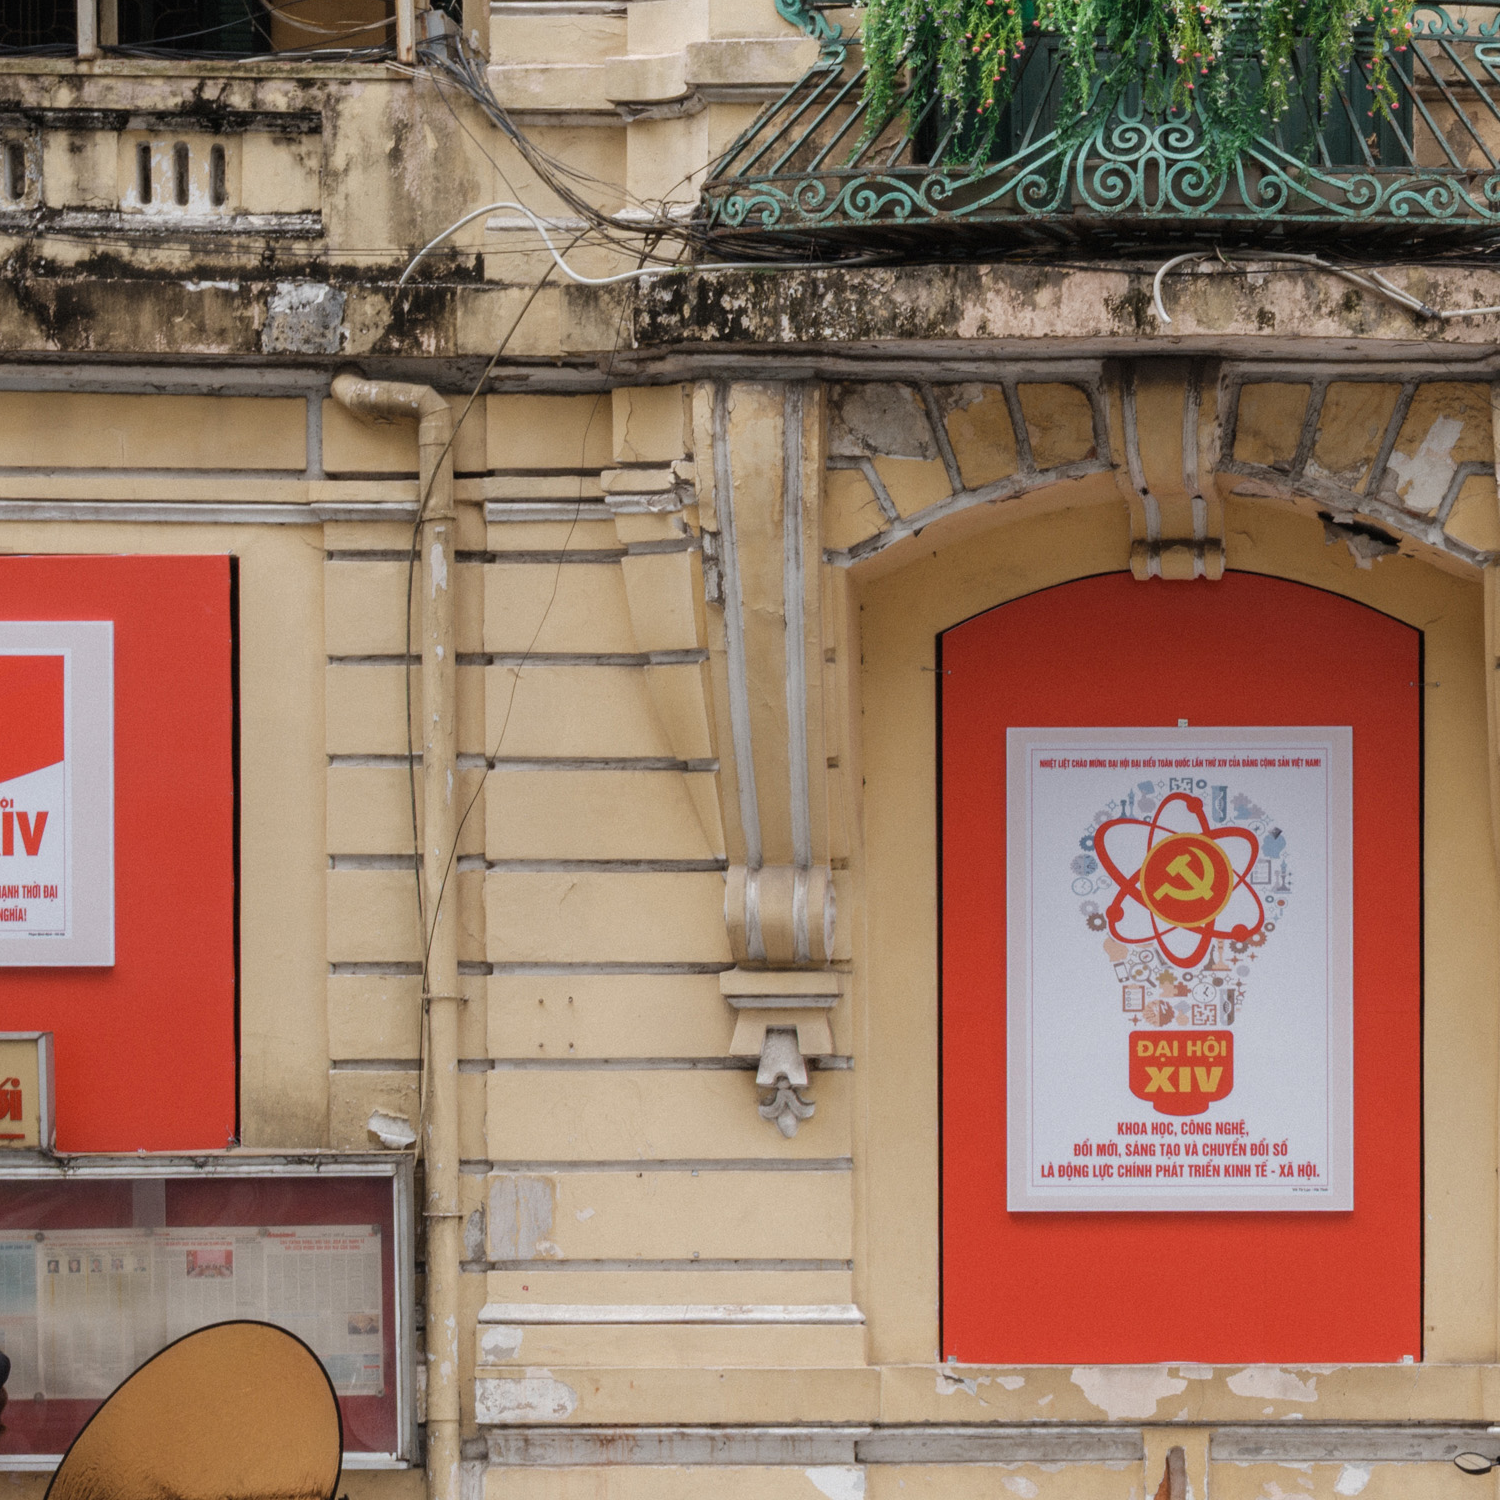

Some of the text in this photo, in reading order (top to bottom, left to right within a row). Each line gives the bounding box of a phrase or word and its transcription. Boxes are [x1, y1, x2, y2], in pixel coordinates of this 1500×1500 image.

[22, 881, 41, 899] THỜI
[43, 885, 58, 902] ĐẠI
[1137, 1036, 1227, 1062] ĐẠI HỘI
[1144, 1066, 1223, 1092] XIV
[1117, 1119, 1250, 1138] KHOA HỌC, CÔNG NGHỆ,
[1073, 1137, 1288, 1160] ĐỔI MỚI, SÁNG TẠO VÀ CHUYỂN ĐỔI SỐ
[1041, 1158, 1320, 1181] LÀ ĐỘNG LỰC CHÍNH PHÁT TRIỂN KINH TẾ XÃ HỘI.
